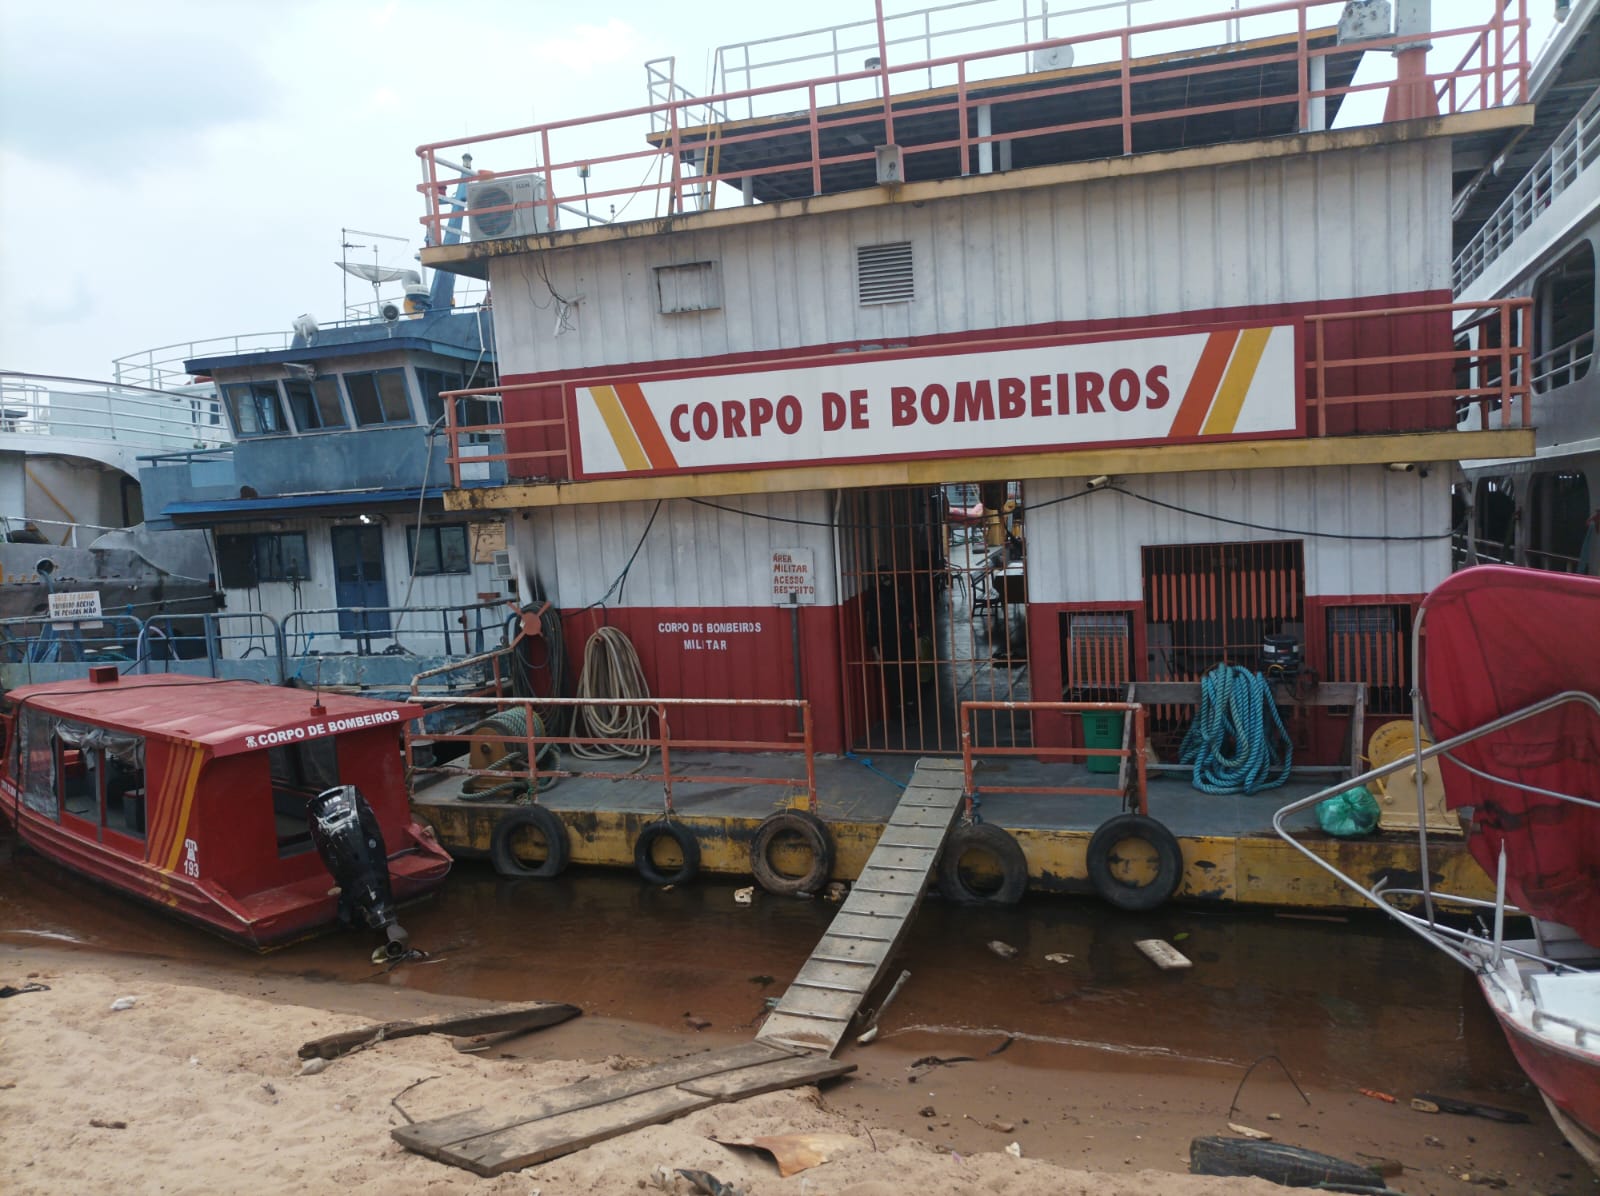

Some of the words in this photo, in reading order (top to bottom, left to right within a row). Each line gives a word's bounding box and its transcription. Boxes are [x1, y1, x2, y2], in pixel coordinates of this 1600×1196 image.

[670, 395, 802, 442] CORPO
[821, 389, 869, 431] DE
[891, 365, 1169, 427] BOMBEIROS
[773, 564, 808, 573] MILITAR
[774, 576, 804, 584] ACESSO
[658, 622, 690, 633] CORPO
[692, 623, 704, 633] DE
[258, 727, 305, 745] CORPO
[307, 723, 326, 736] DE
[328, 710, 400, 732] BOMBEIROS
[184, 859, 200, 878] 193
